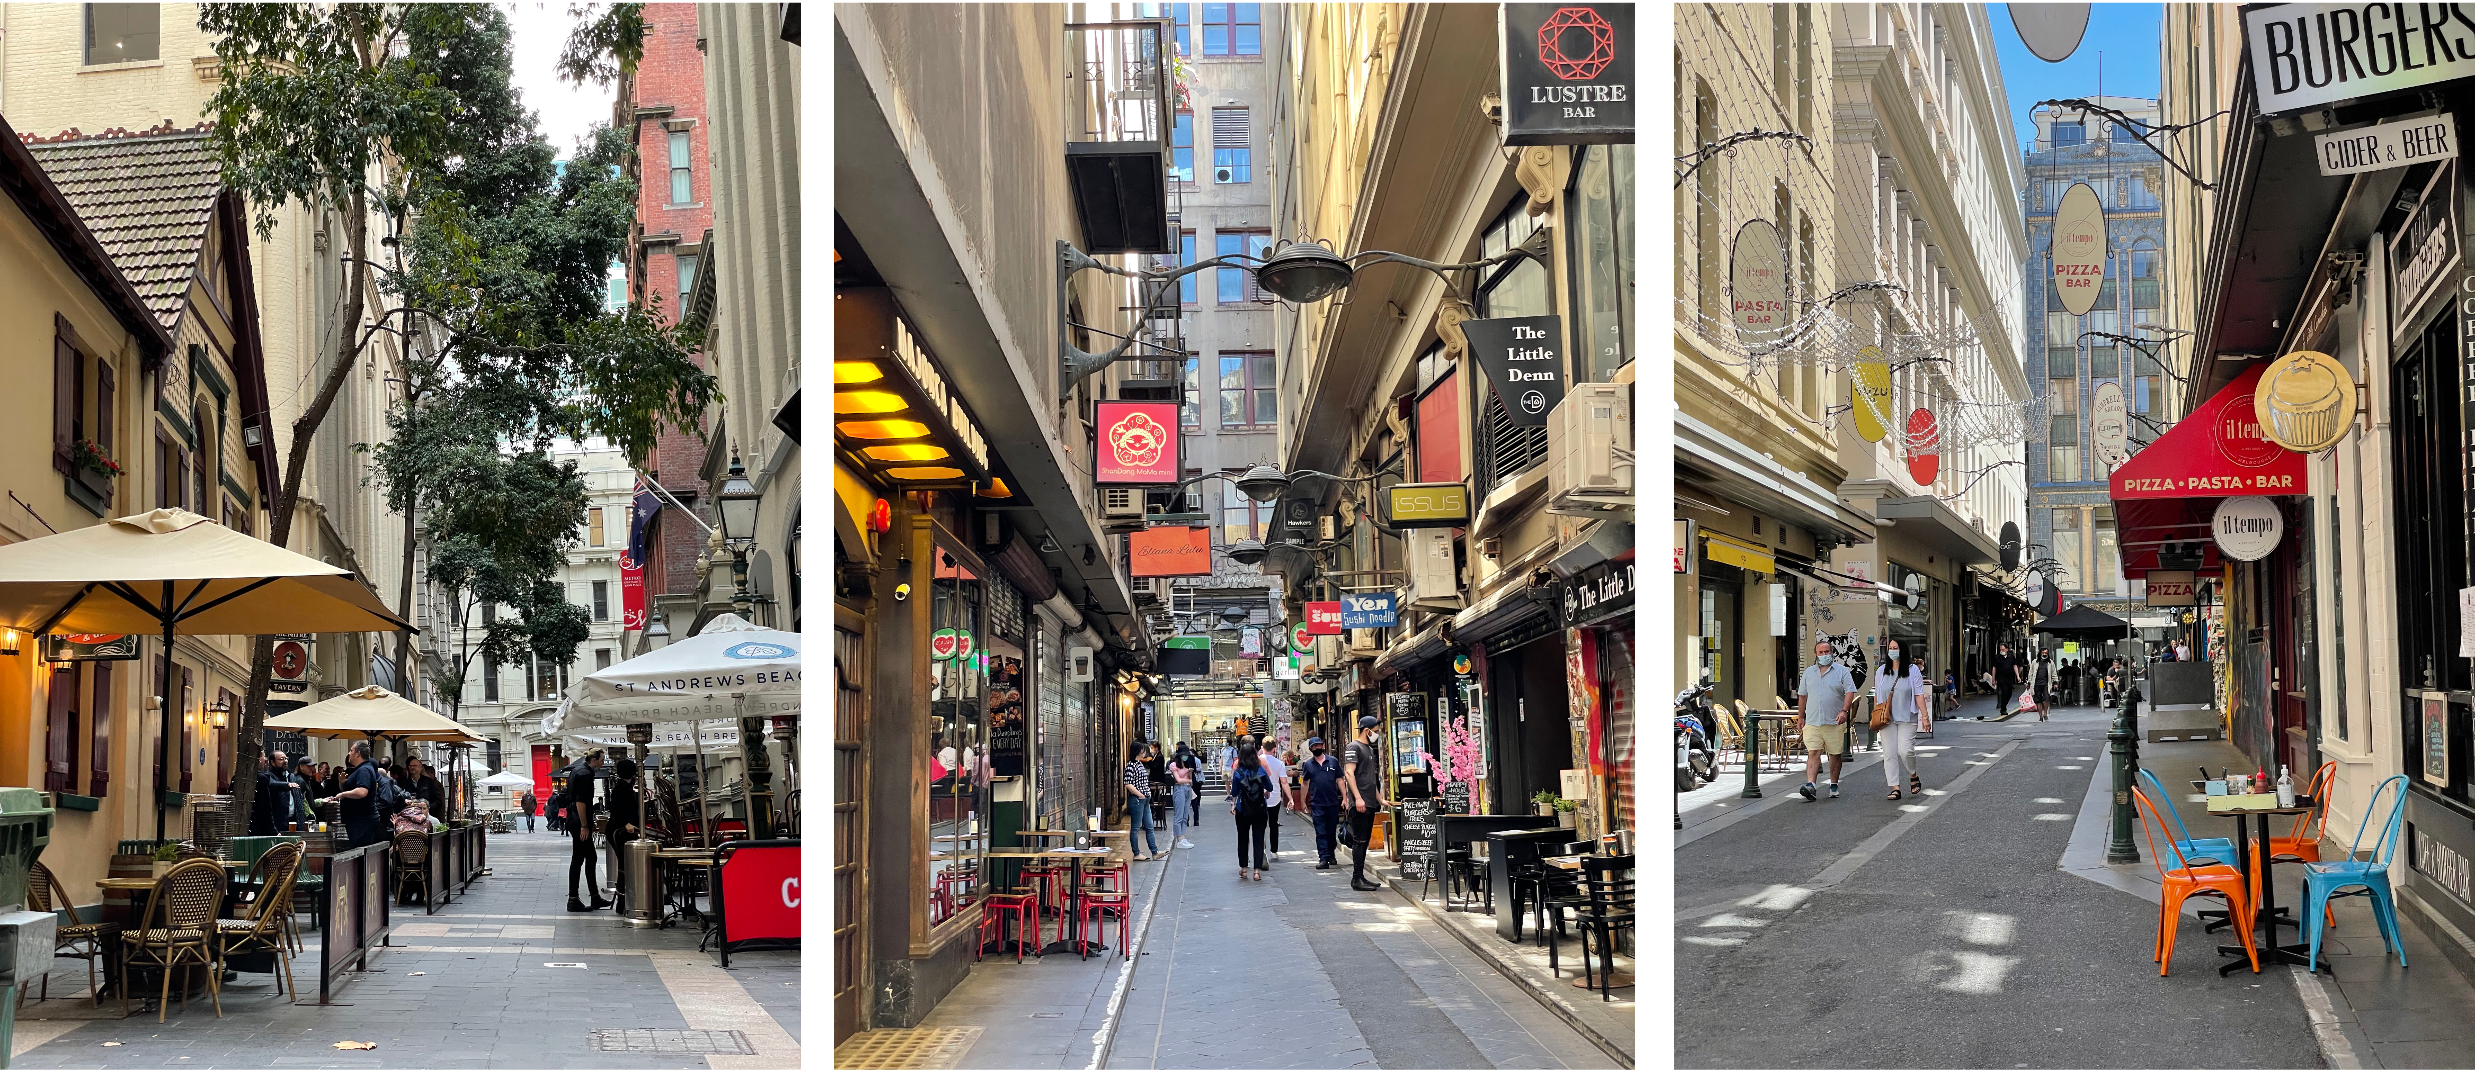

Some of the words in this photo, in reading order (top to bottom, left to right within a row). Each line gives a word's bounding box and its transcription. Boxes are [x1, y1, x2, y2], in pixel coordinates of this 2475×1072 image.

[1531, 85, 1626, 104] LUSTRE
[1563, 106, 1596, 119] BAR
[2324, 135, 2381, 171] CIDER
[2386, 144, 2397, 161] &
[2402, 123, 2449, 159] BEER
[2072, 234, 2093, 245] tempo
[2056, 264, 2101, 276] PIZZA
[2399, 217, 2446, 315] BURGERS
[2066, 279, 2091, 288] BAR
[1735, 301, 1783, 311] PASTA
[1747, 315, 1771, 323] BAR
[1512, 325, 1546, 340] The
[1507, 347, 1554, 361] Little
[1508, 368, 1555, 382] Denn
[2226, 419, 2235, 439] il
[2237, 417, 2263, 440] tem
[1101, 467, 1135, 476] ShanDong
[2124, 478, 2175, 491] PIZZA
[2188, 476, 2243, 490] PASTA
[2256, 474, 2292, 488] BAR
[2223, 515, 2231, 535] il
[2233, 514, 2273, 537] tempo
[1285, 537, 1304, 545] SAMPLE
[1138, 545, 1174, 557] Eliana
[1176, 543, 1204, 555] Lulu
[1578, 584, 1597, 610] The
[1598, 571, 1624, 603] Little
[1626, 564, 1635, 592] D
[2147, 584, 2194, 596] PIZZA
[1347, 597, 1389, 612] Yen
[1312, 612, 1342, 622] sou
[1343, 612, 1366, 626] Sushi
[273, 683, 301, 691] TAVERN
[614, 682, 635, 692] ST
[648, 674, 745, 692] ANDREWS
[602, 737, 661, 745] ANDS
[667, 732, 707, 742] BEAH
[992, 738, 1010, 749] EVERY
[1010, 737, 1022, 749] DAY
[1447, 803, 1462, 813] $6
[2458, 853, 2471, 904] BAR
[781, 876, 800, 909] C
